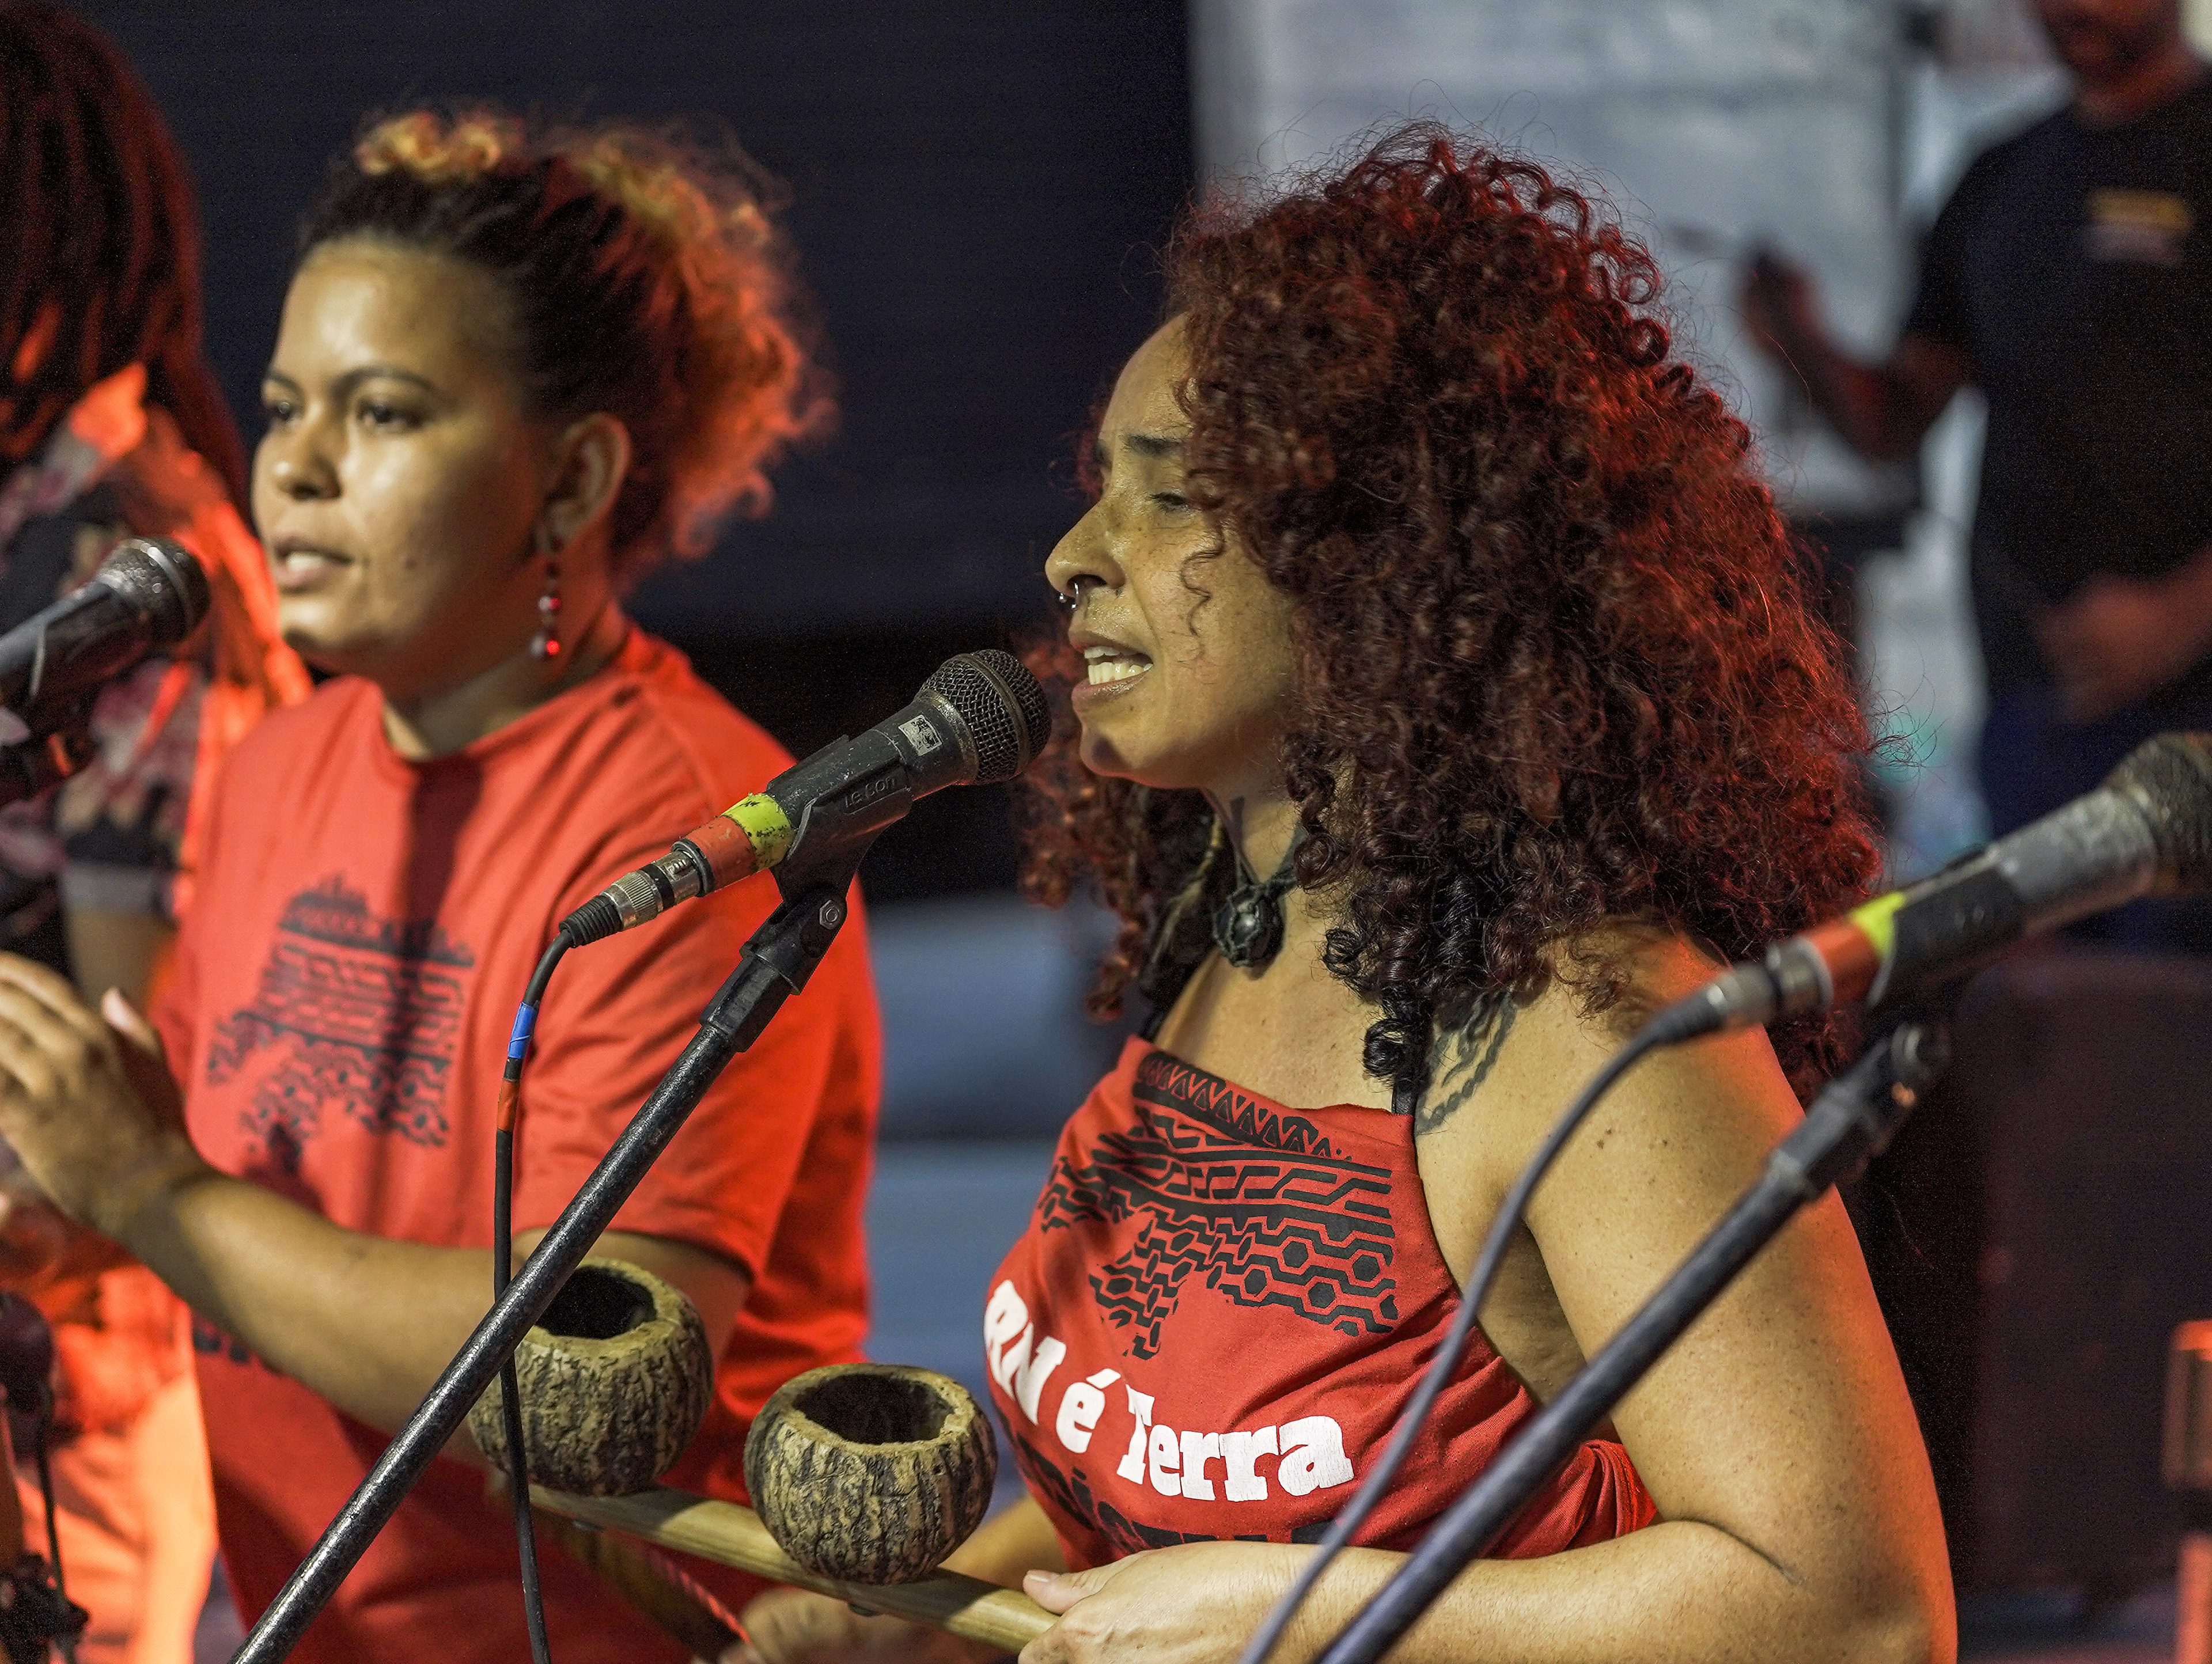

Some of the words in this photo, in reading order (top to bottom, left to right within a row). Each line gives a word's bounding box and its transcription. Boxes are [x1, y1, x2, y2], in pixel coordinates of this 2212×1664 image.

[983, 1279, 1066, 1425] RN
[1055, 1368, 1122, 1454] é
[1116, 1383, 1355, 1502] Terra
